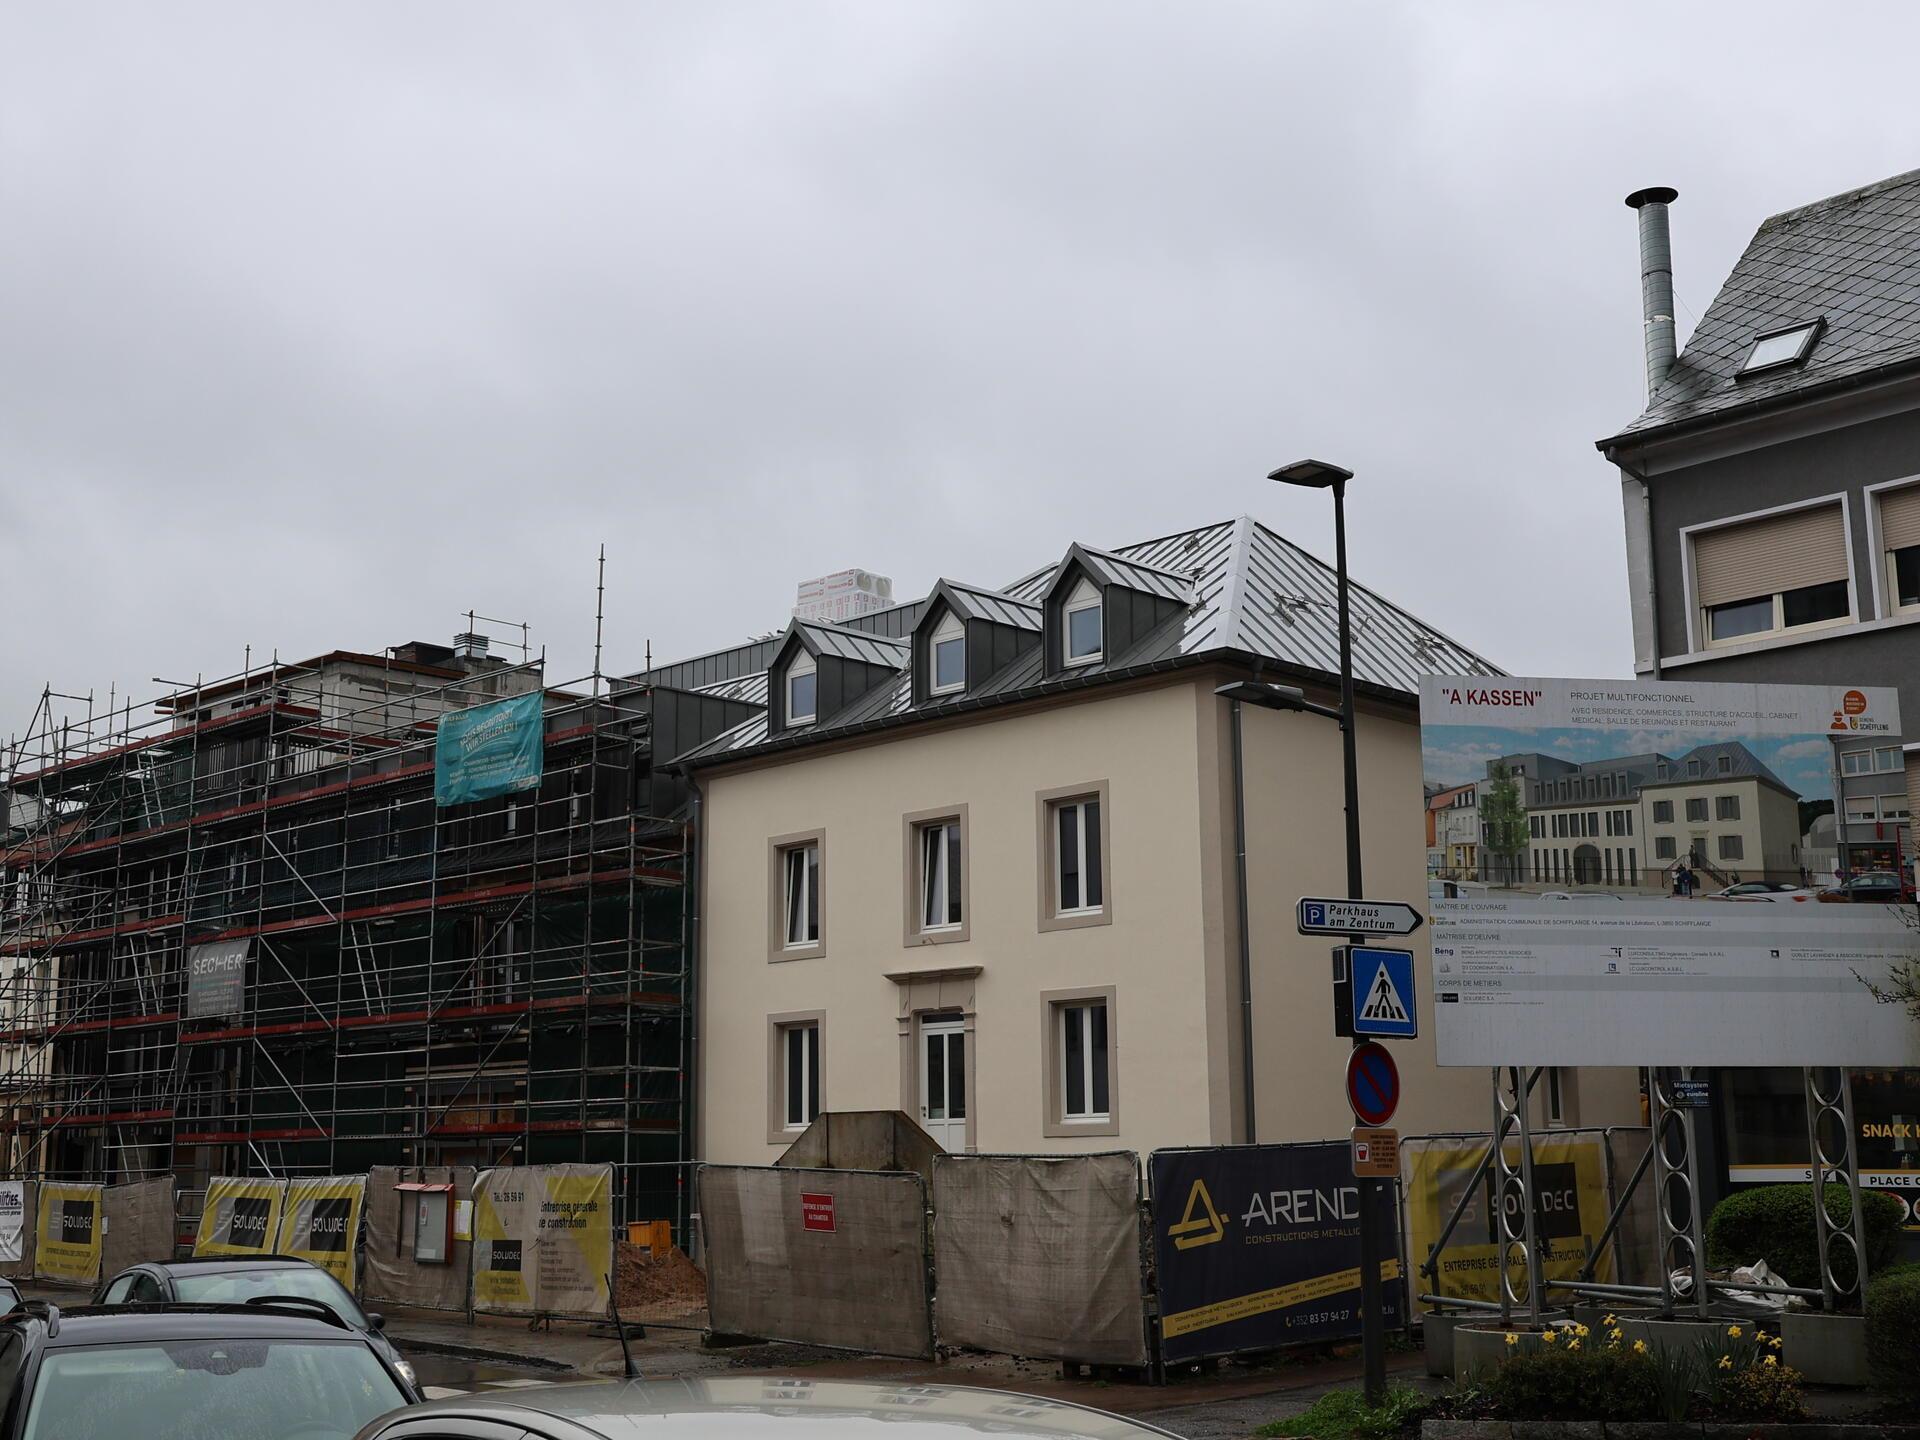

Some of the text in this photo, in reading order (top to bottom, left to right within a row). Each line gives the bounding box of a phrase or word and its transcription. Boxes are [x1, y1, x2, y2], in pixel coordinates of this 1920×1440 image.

[1442, 689, 1542, 707] "A KASSEN"
[1570, 691, 1696, 703] PROJET MULTIFONCTIONNEL
[1606, 717, 1629, 725] SALLE
[1690, 719, 1737, 727] RESTAURANT
[1769, 712, 1798, 720] CABINET
[1329, 904, 1379, 917] Parkhaus
[1329, 917, 1395, 930] am Zentrum
[1459, 918, 1506, 926] ADMINISTRATION
[1434, 947, 1454, 956] Beng
[193, 953, 244, 976] SECHER
[1438, 979, 1461, 987] CORPS
[1862, 1123, 1912, 1138] SNACK
[1869, 1176, 1910, 1186] PLACE
[503, 1192, 510, 1202] 26
[1241, 1186, 1383, 1227] AREND
[63, 1215, 93, 1229] SOLUDEC
[233, 1213, 268, 1232] SOLUDEC
[1245, 1230, 1320, 1245] CONSTRUCTIONS
[491, 1250, 522, 1261] SOLUDEC
[1443, 1256, 1487, 1273] ENTREPRISE
[1309, 1313, 1319, 1324] 83
[1320, 1312, 1329, 1323] 57
[1330, 1311, 1340, 1321] 94
[1340, 1310, 1350, 1320] 27
